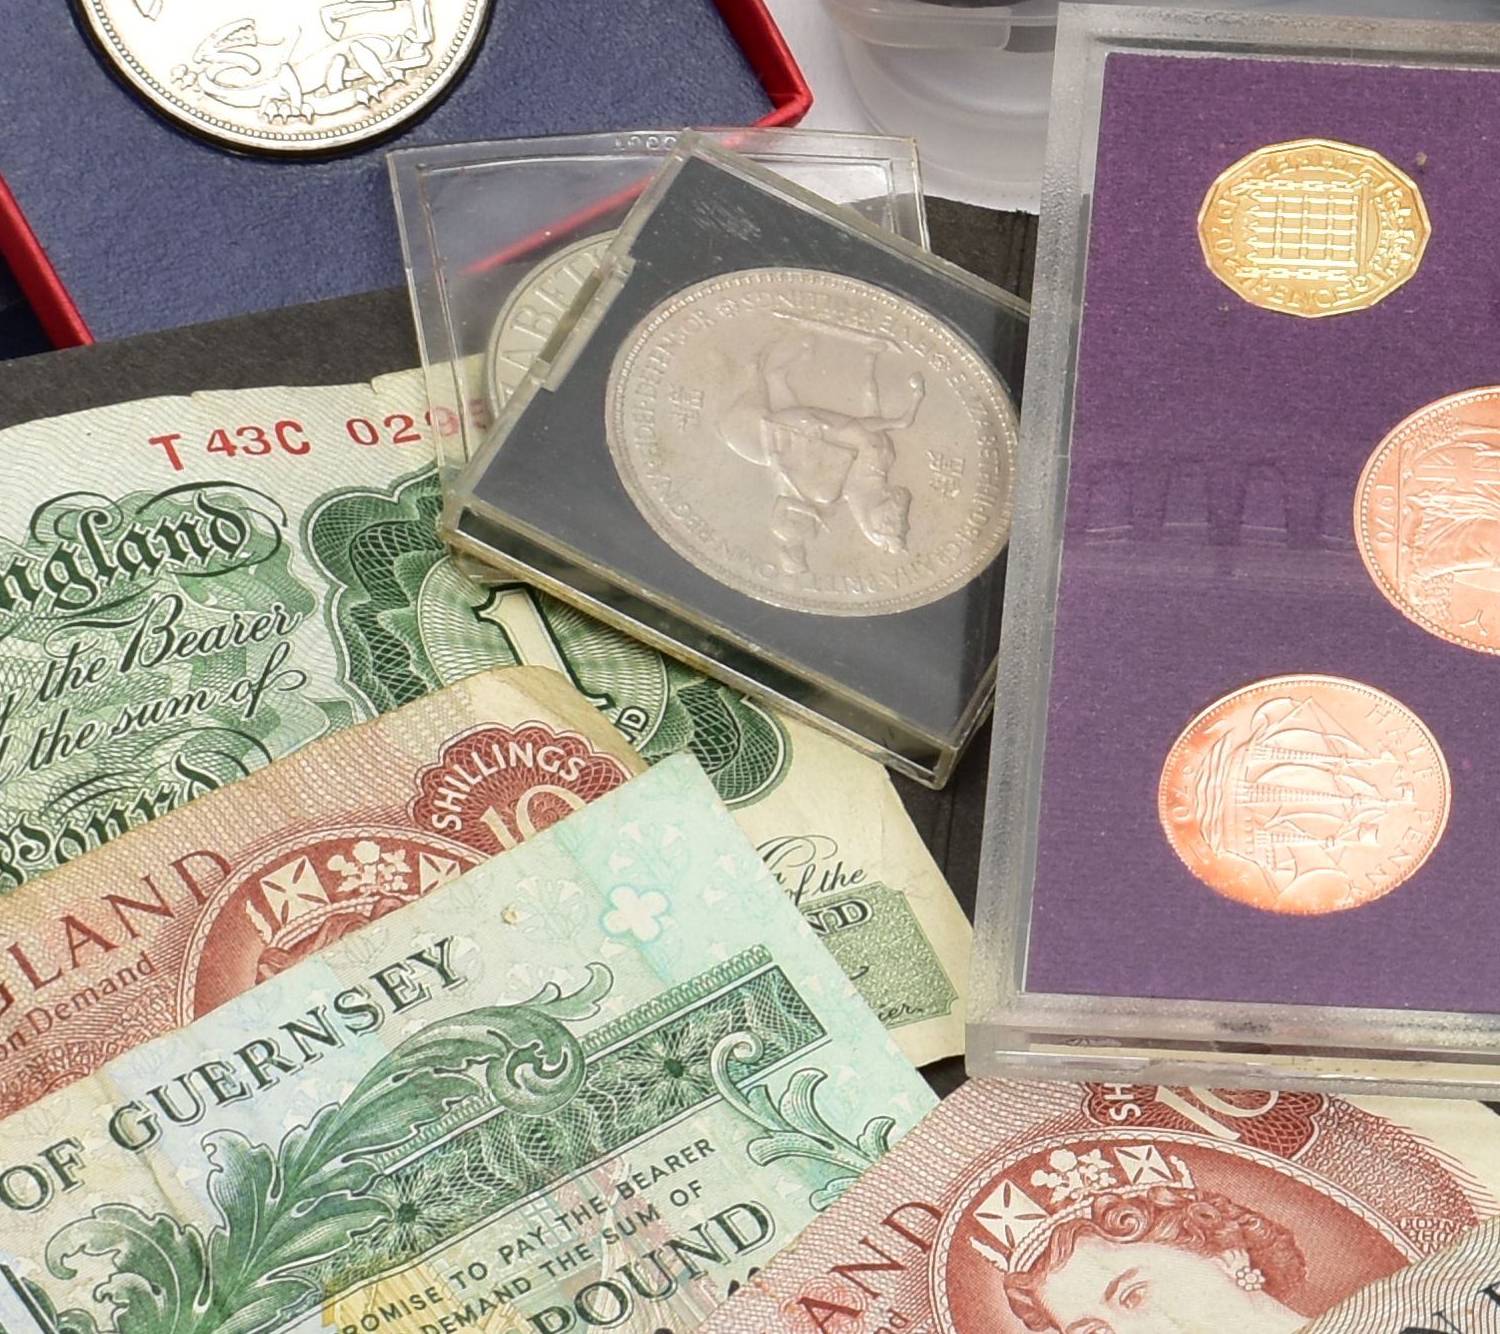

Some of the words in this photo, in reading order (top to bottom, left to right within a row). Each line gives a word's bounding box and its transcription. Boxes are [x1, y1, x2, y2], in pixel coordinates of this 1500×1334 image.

[148, 433, 185, 472] T
[206, 420, 311, 457] 43C
[1374, 483, 1398, 547] 1970
[40, 638, 106, 703] the
[100, 592, 305, 677] Bearer
[20, 707, 102, 773] the
[106, 687, 222, 739] sum
[228, 639, 308, 723] of
[1367, 703, 1434, 779] HALF
[432, 739, 588, 834] SHILLINGS
[30, 953, 157, 1043] Demand
[108, 935, 476, 1150] GUERNSEY
[450, 1259, 489, 1289] TO
[499, 1227, 548, 1267] PAY
[553, 1196, 608, 1235] THE
[619, 1135, 716, 1202] BEARER
[539, 1240, 598, 1279] THE
[600, 1201, 660, 1247] SUM
[669, 1178, 706, 1210] OF
